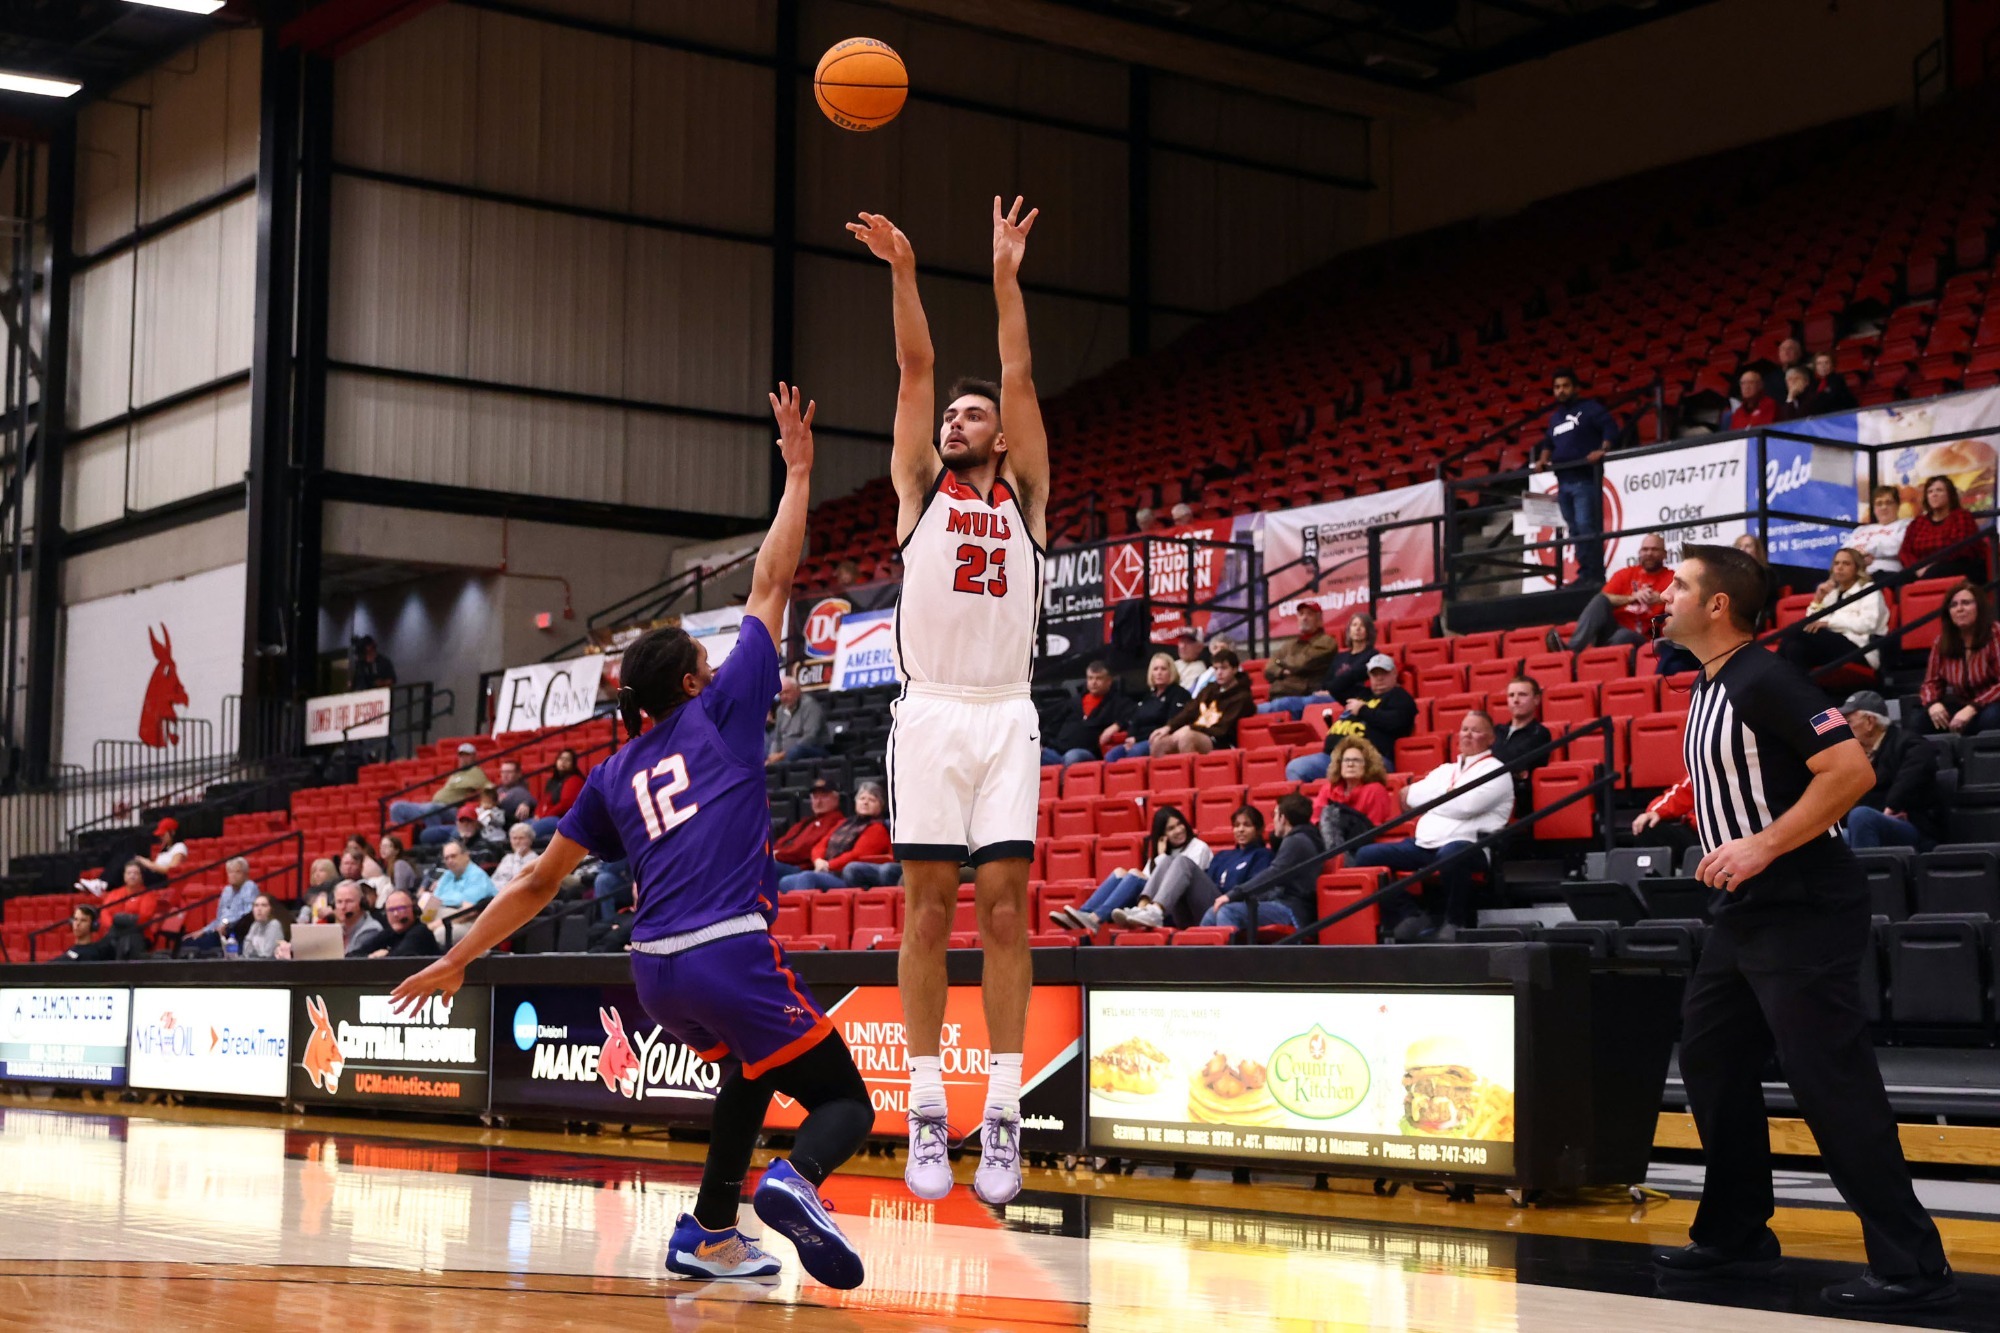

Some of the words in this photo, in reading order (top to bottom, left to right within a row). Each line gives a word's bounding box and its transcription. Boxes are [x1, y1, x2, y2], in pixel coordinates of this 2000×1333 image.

[1624, 460, 1739, 493] (660)747-1777
[1659, 503, 1704, 523] Order
[1320, 527, 1376, 547] NATION
[1702, 523, 1718, 540] at
[1791, 534, 1838, 551] Simpson
[1149, 549, 1213, 576] STUDNT
[846, 648, 893, 667] AMERIC
[551, 685, 594, 717] BANK
[632, 753, 699, 841] 12
[84, 996, 113, 1020] CLUB
[845, 1021, 908, 1045] UNIVER
[940, 1023, 961, 1047] OF
[532, 1043, 600, 1082] MAKE
[850, 1045, 900, 1072] TRAL
[1275, 1052, 1344, 1082] Country
[355, 1073, 460, 1098] UCMathletics.com
[1294, 1077, 1355, 1103] Kitchen
[871, 1089, 911, 1113] ONL
[1147, 1127, 1162, 1142] THE
[1264, 1135, 1303, 1153] HIGHWAY
[1304, 1136, 1318, 1153] 50
[1319, 1137, 1327, 1153] &
[1417, 1144, 1487, 1165] 660-747-3149
